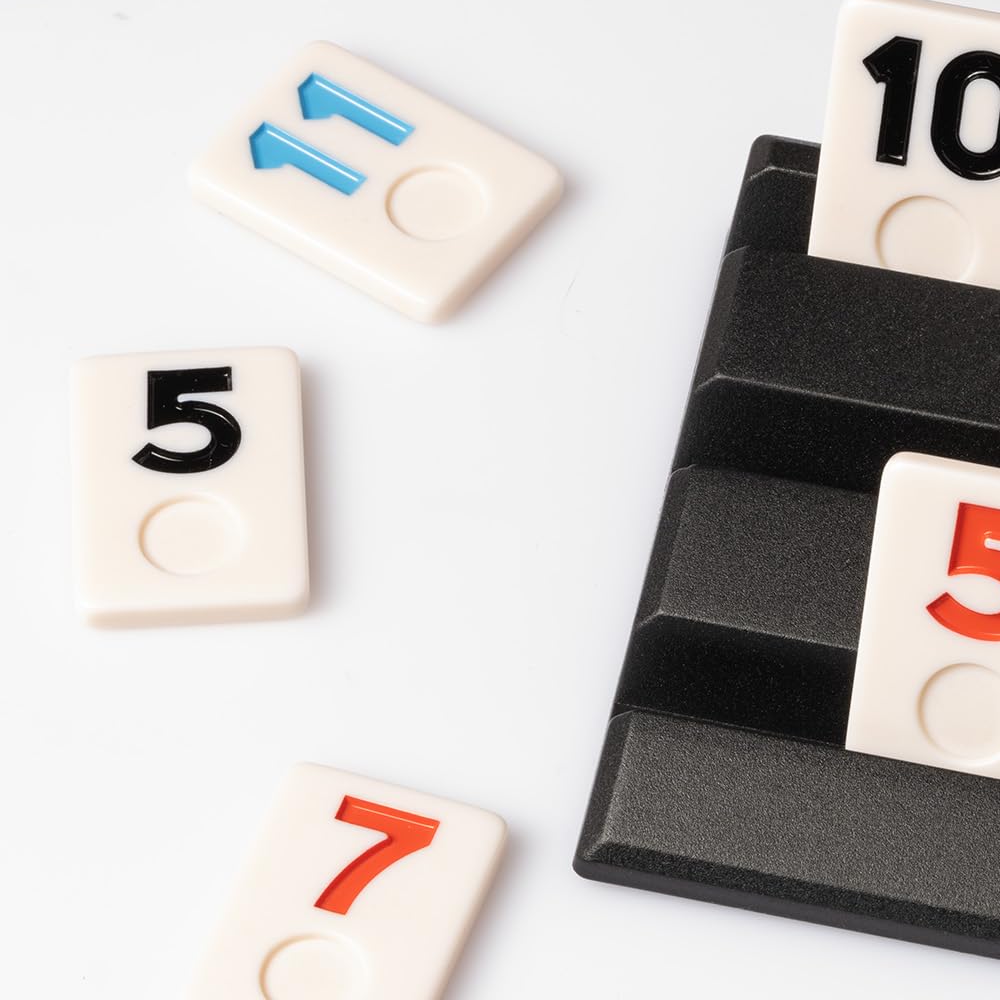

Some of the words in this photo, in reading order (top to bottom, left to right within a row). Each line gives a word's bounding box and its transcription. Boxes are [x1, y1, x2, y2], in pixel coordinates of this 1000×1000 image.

[250, 74, 413, 194] 11
[132, 367, 241, 473] 5
[314, 795, 440, 915] 7
